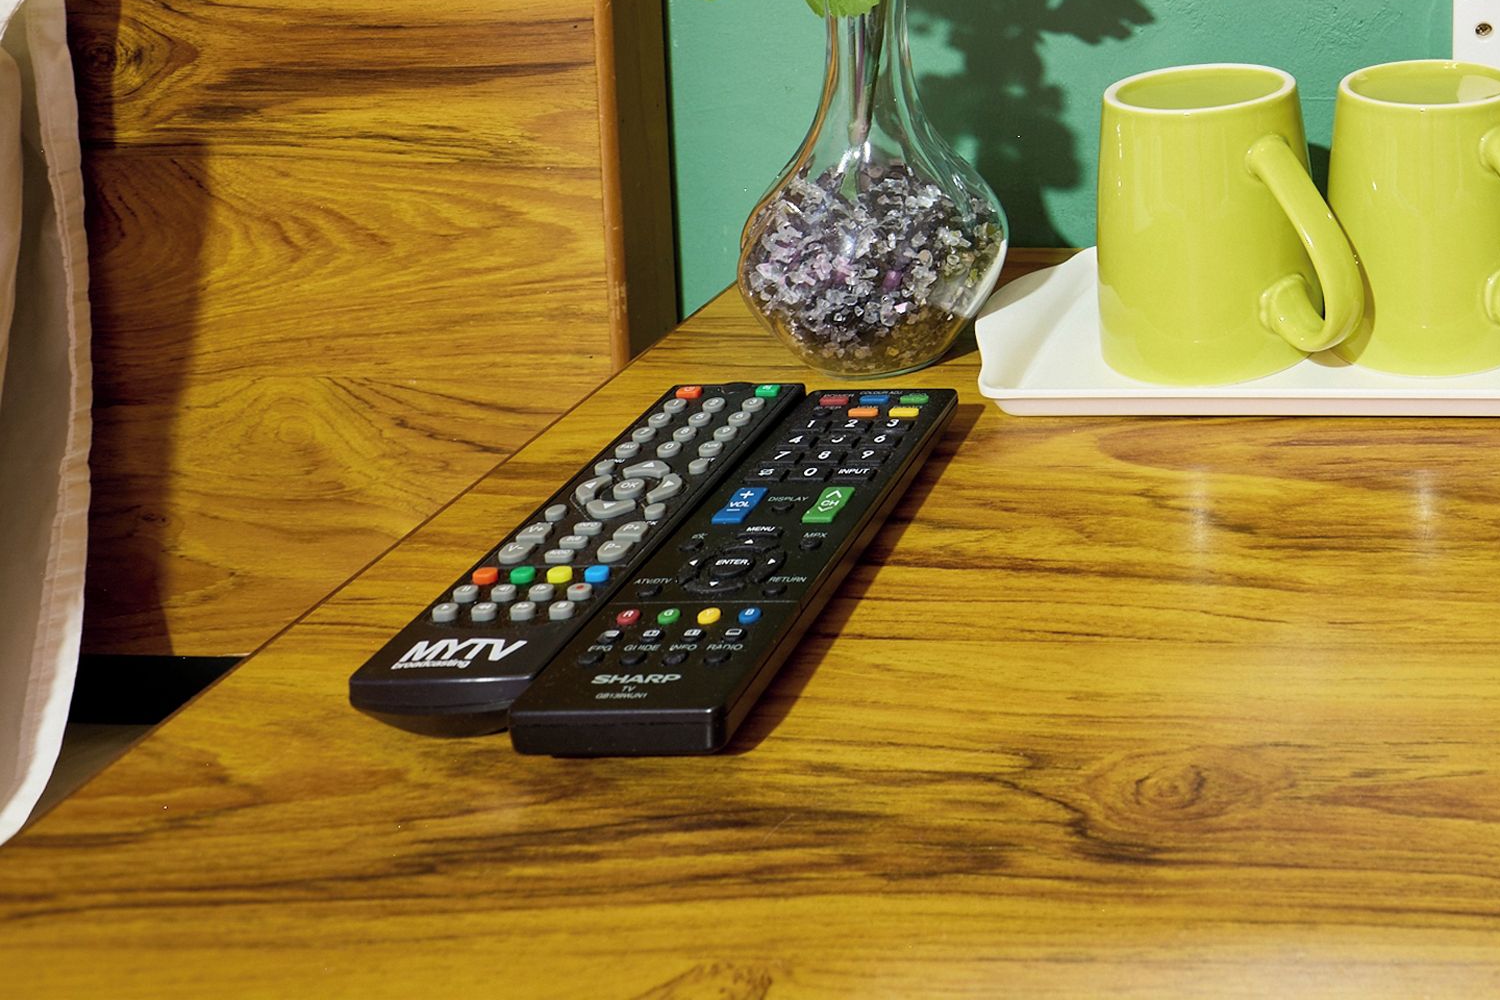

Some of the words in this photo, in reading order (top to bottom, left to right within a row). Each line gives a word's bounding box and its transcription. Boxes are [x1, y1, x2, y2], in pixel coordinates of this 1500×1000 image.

[806, 419, 816, 428] 1
[844, 419, 859, 428] 2
[886, 419, 900, 428] 3
[788, 435, 804, 444] 4
[873, 434, 886, 443] 6
[774, 450, 791, 460] 7
[818, 450, 832, 460] 8
[861, 450, 875, 459] 9
[803, 467, 818, 477] 0
[838, 467, 870, 475] INPUT
[620, 481, 638, 489] OK
[746, 525, 776, 533] MENU
[663, 609, 674, 617] G
[399, 637, 528, 662] MYTV
[706, 643, 744, 651] RADIO
[390, 659, 471, 670] broadcasting
[591, 673, 682, 684] SHARP
